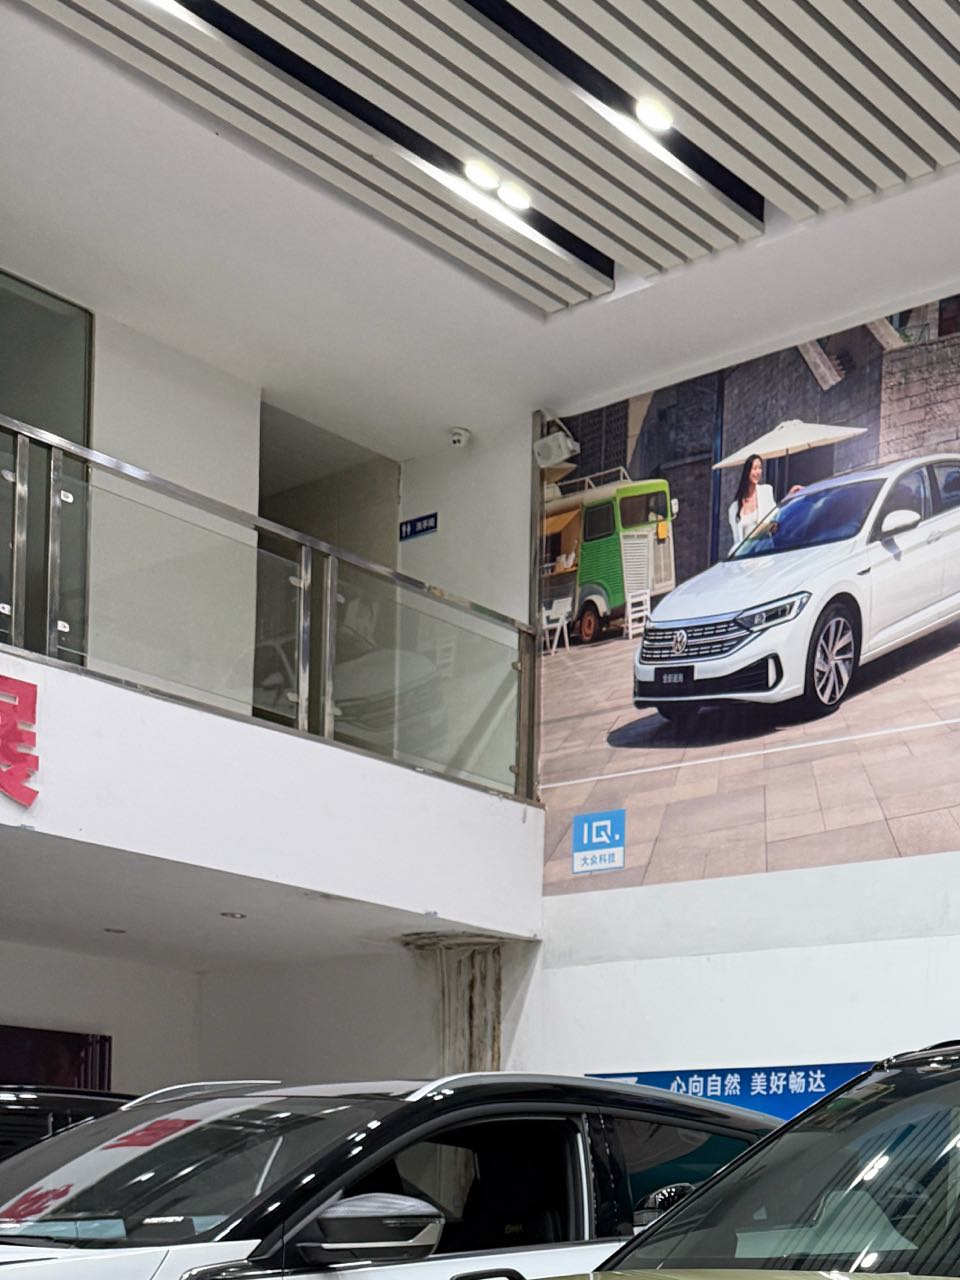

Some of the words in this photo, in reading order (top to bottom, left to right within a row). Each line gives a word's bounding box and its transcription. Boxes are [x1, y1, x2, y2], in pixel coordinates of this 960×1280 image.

[581, 852, 615, 868] 大众科技
[670, 1073, 742, 1096] 心向自然
[750, 1070, 826, 1095] 美好畅达
